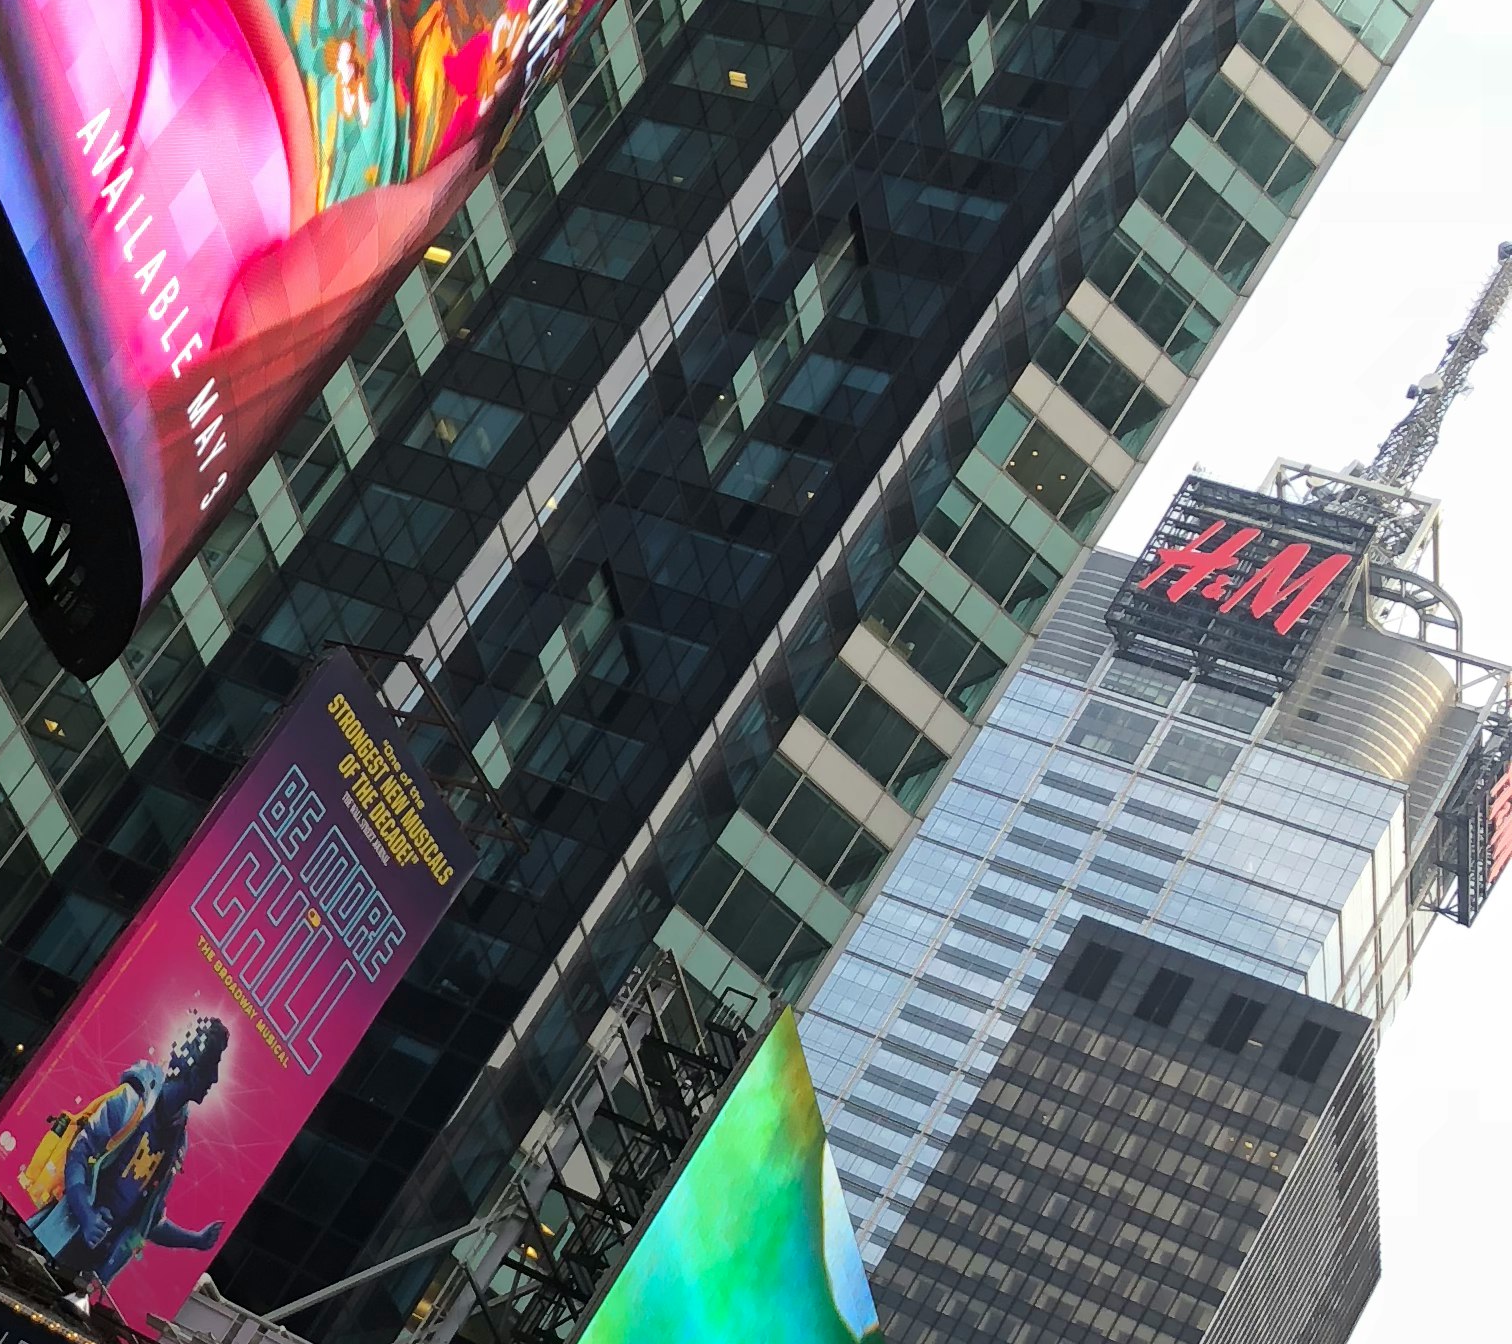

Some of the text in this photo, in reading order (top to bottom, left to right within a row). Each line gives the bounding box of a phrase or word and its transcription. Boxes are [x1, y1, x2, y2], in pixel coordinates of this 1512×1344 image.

[76, 107, 203, 379] AVAILABLE
[186, 377, 228, 473] MAY
[1138, 519, 1353, 636] H&M
[327, 693, 454, 886] STRONGEST NEW MUSICALS
[338, 753, 361, 779] OF
[351, 771, 379, 810] THE
[400, 772, 413, 787] of
[409, 785, 425, 810] the
[259, 764, 406, 982] BE MORE
[197, 934, 290, 1068] THE BROADWAY MUSICAL
